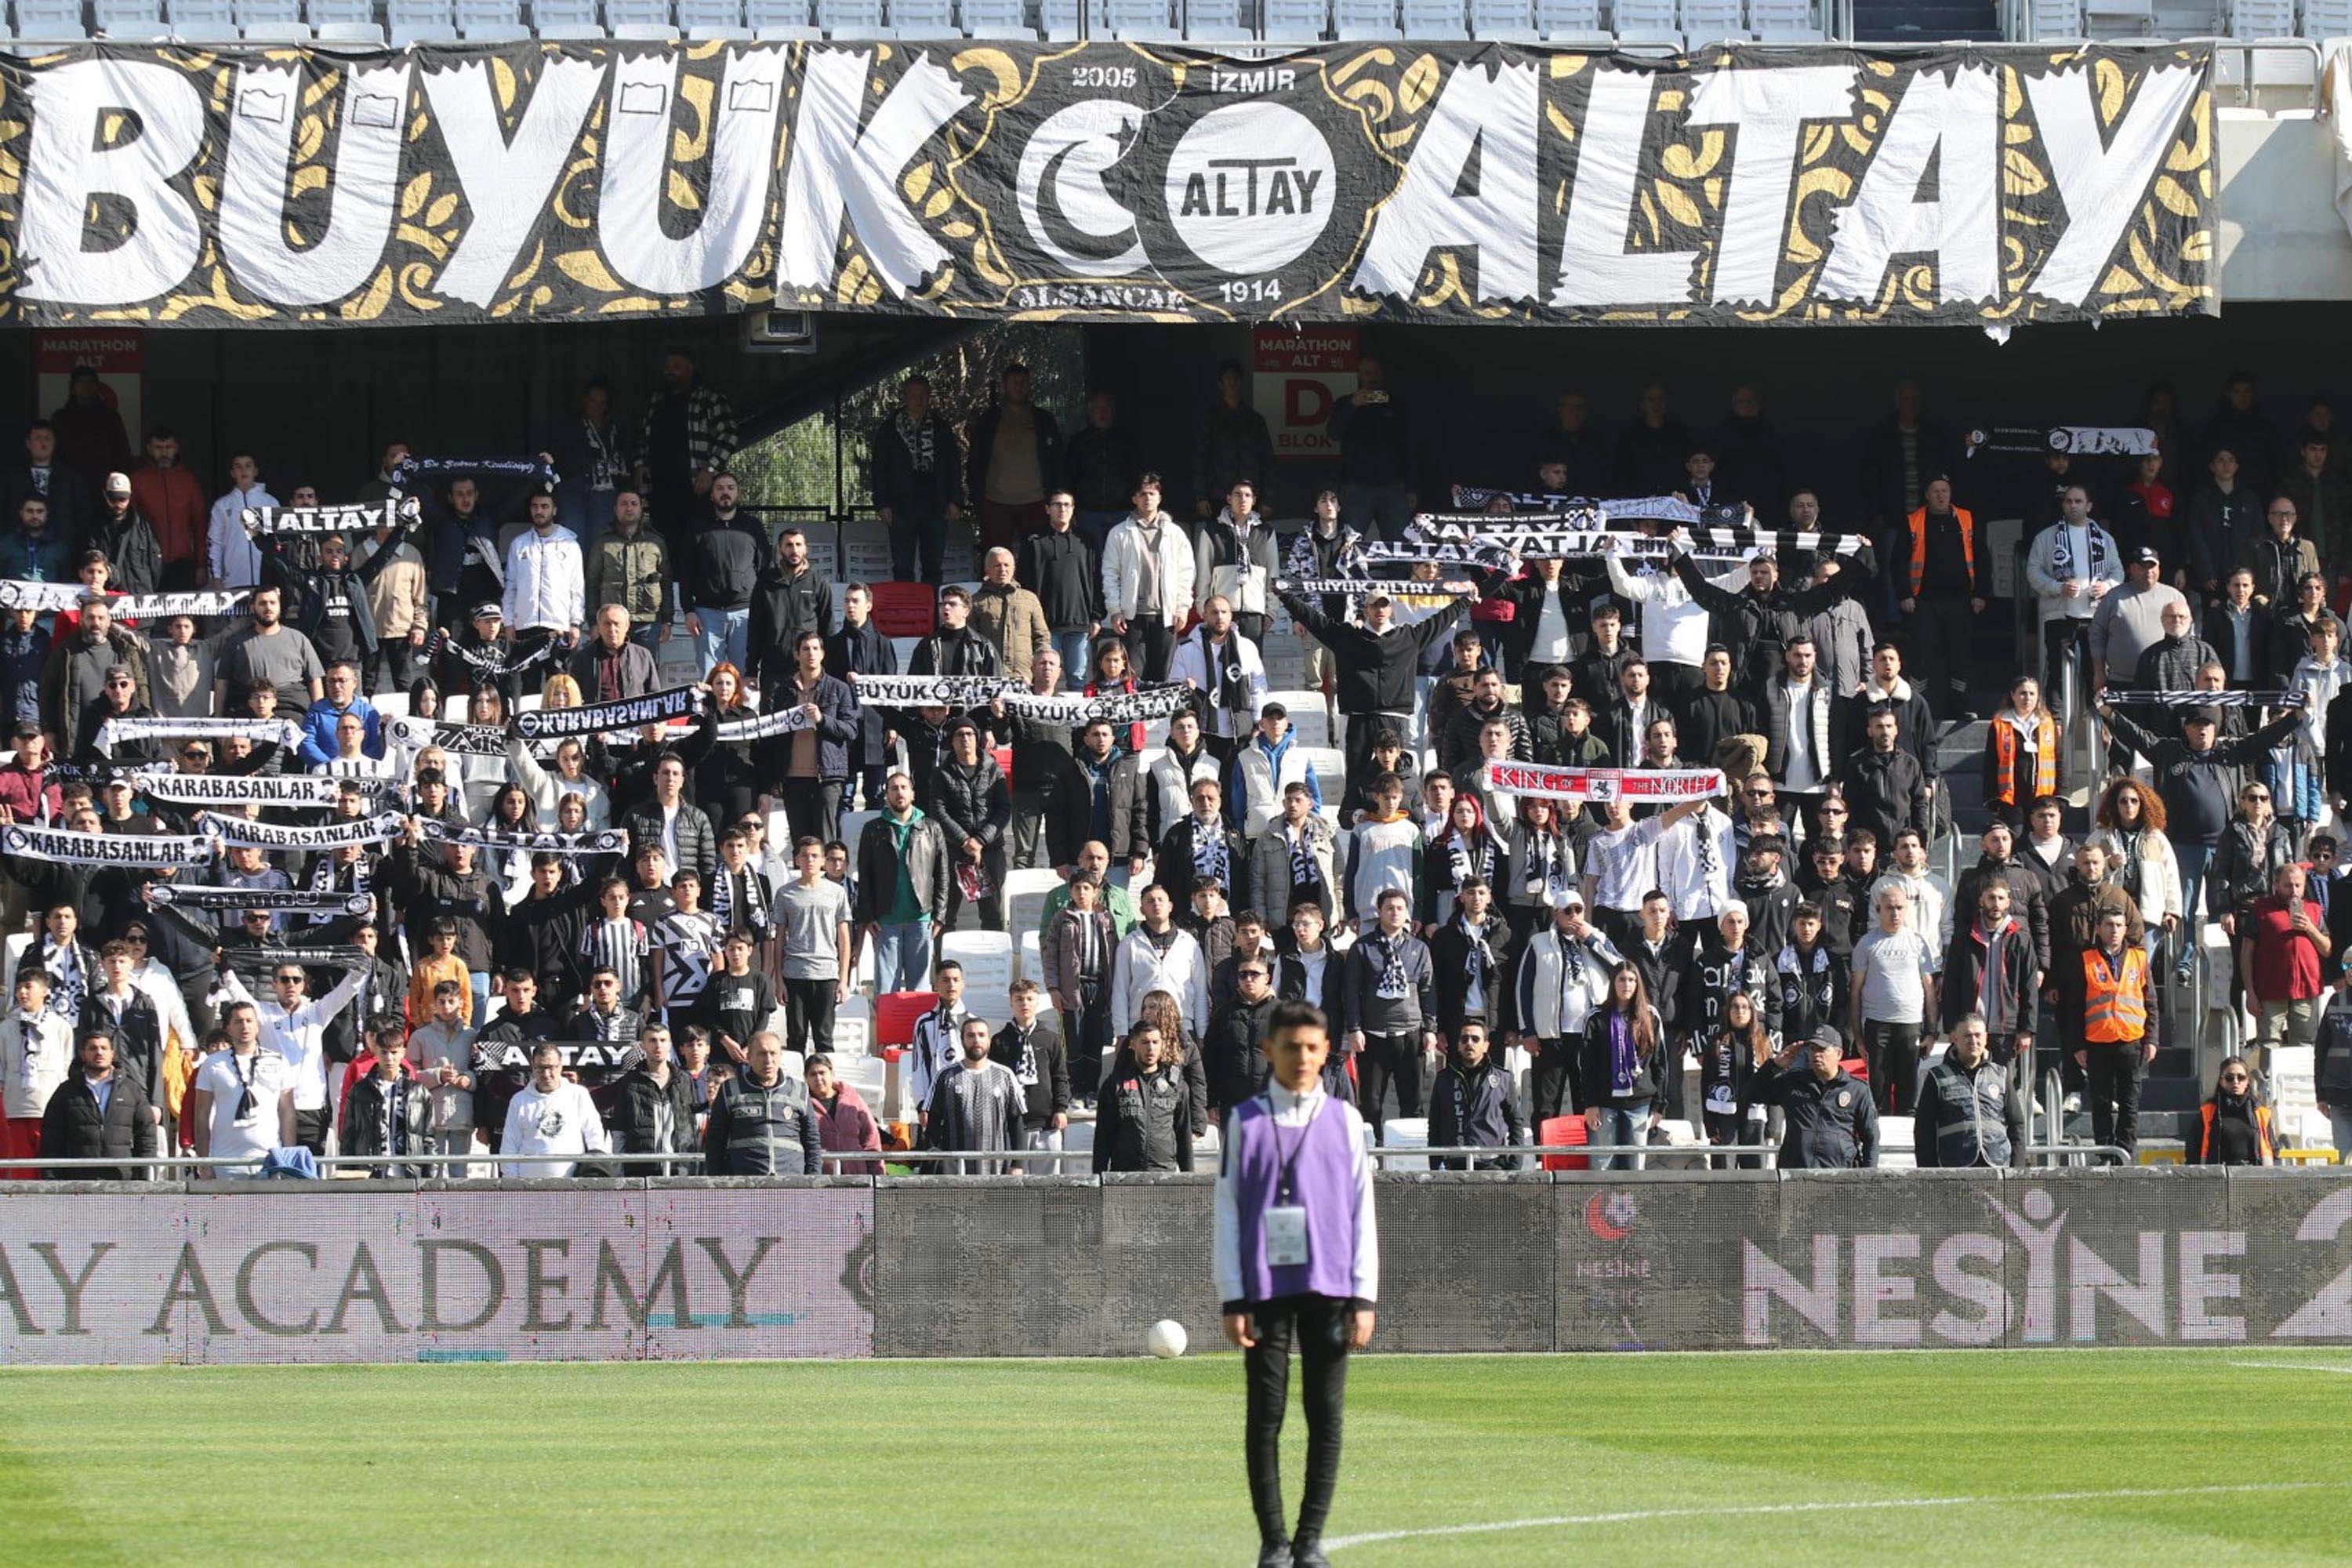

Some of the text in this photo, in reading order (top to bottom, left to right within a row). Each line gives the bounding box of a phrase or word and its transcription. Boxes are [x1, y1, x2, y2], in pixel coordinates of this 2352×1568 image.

[1072, 66, 1138, 90] 2005
[1210, 64, 1295, 93] İZMİR
[1181, 158, 1323, 217] ALTAY
[1348, 60, 2203, 310] ALTAY
[1219, 279, 1281, 303] 1914
[42, 339, 136, 351] MARATHON
[1261, 339, 1351, 351] MARATHON
[75, 355, 104, 368] ALT
[1292, 354, 1320, 367] ALT
[1286, 379, 1333, 427] D
[1279, 434, 1332, 448] BLOK
[278, 511, 383, 532] ALTAY
[1367, 541, 1483, 560] ALTAY
[855, 681, 928, 700] BÜYÜK
[1007, 695, 1179, 722] BÜYÜK ALTAY
[158, 778, 314, 800] KARABASANLAR
[1501, 768, 1708, 796] KING OF THE NORTH
[223, 819, 376, 845] KARABASANLAR
[458, 827, 584, 849] ALTAY
[30, 833, 186, 862] KARABASANLAR
[201, 891, 320, 909] ALTAY
[501, 1046, 633, 1066] ATAY
[142, 1237, 780, 1336] ACADEMY
